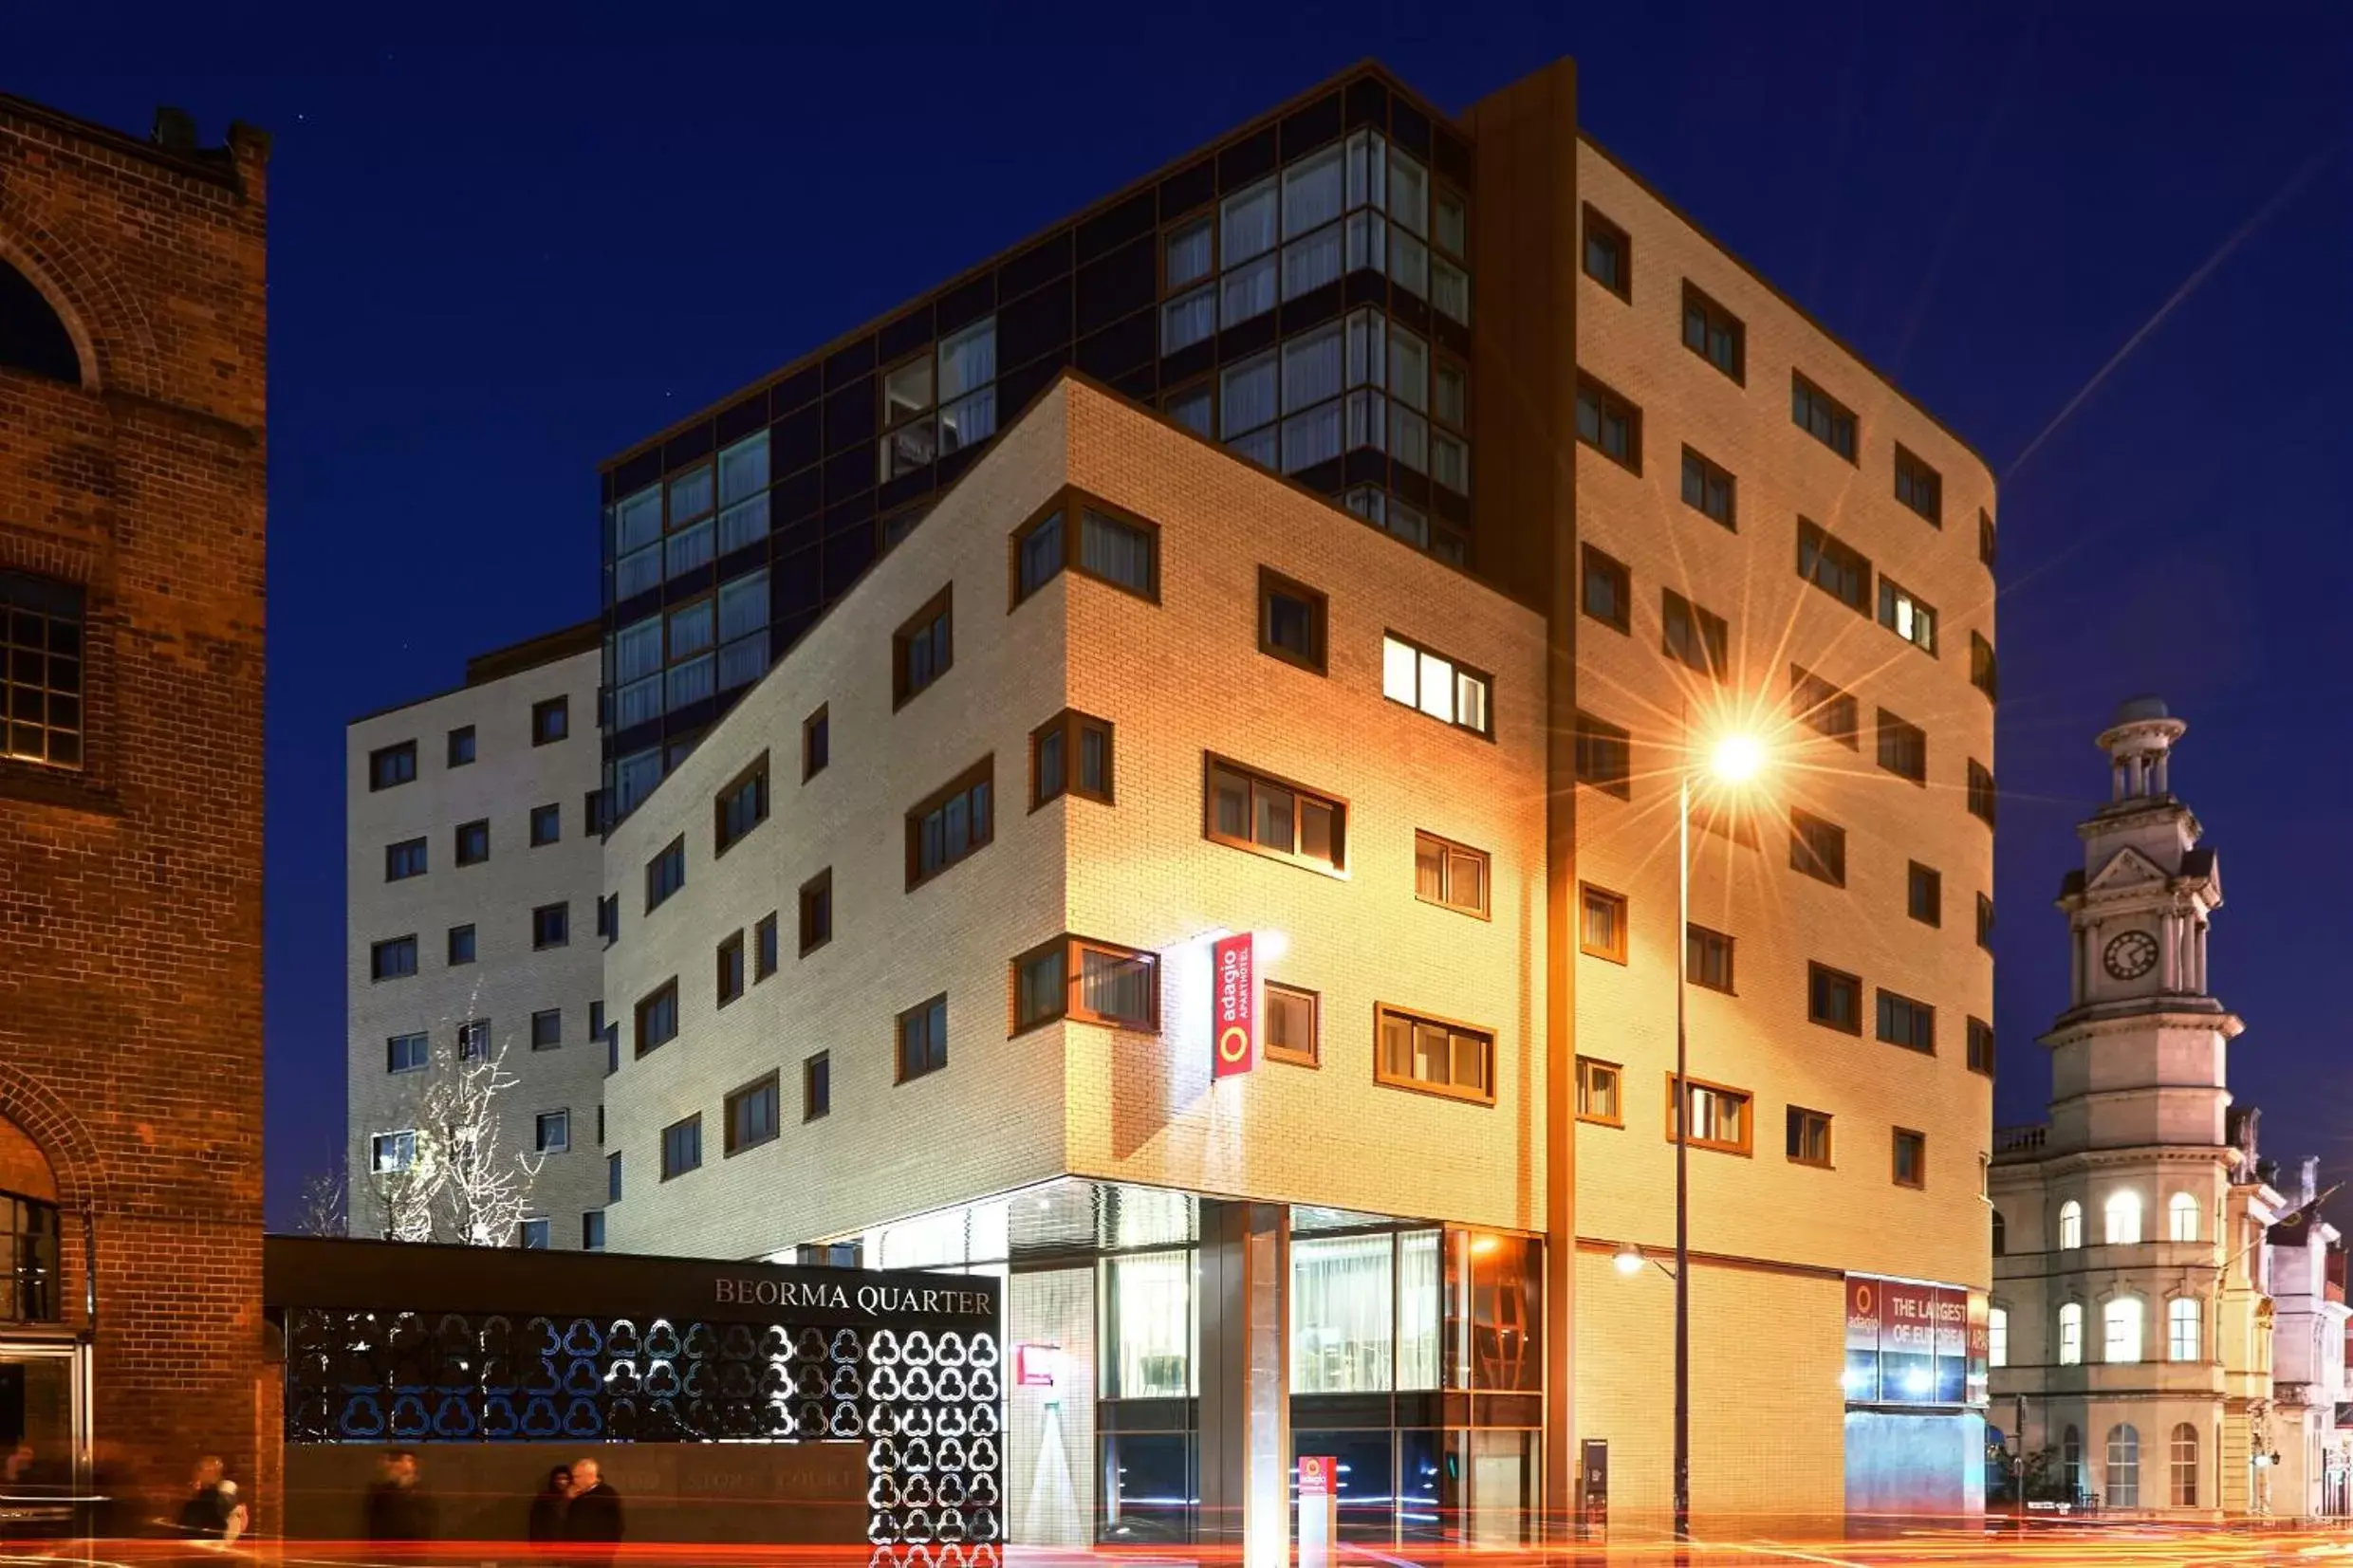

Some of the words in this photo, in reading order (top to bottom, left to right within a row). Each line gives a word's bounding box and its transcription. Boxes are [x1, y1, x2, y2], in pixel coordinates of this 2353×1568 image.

[1220, 950, 1240, 1022] adagio
[1239, 947, 1248, 1019] APARTHOTEL
[714, 1278, 850, 1309] BEORMA
[857, 1285, 993, 1317] QUARTER
[1892, 1297, 1916, 1319] THE
[1918, 1300, 1967, 1322] LARGEST
[1847, 1313, 1878, 1334] adagio
[1893, 1323, 1911, 1343] OF
